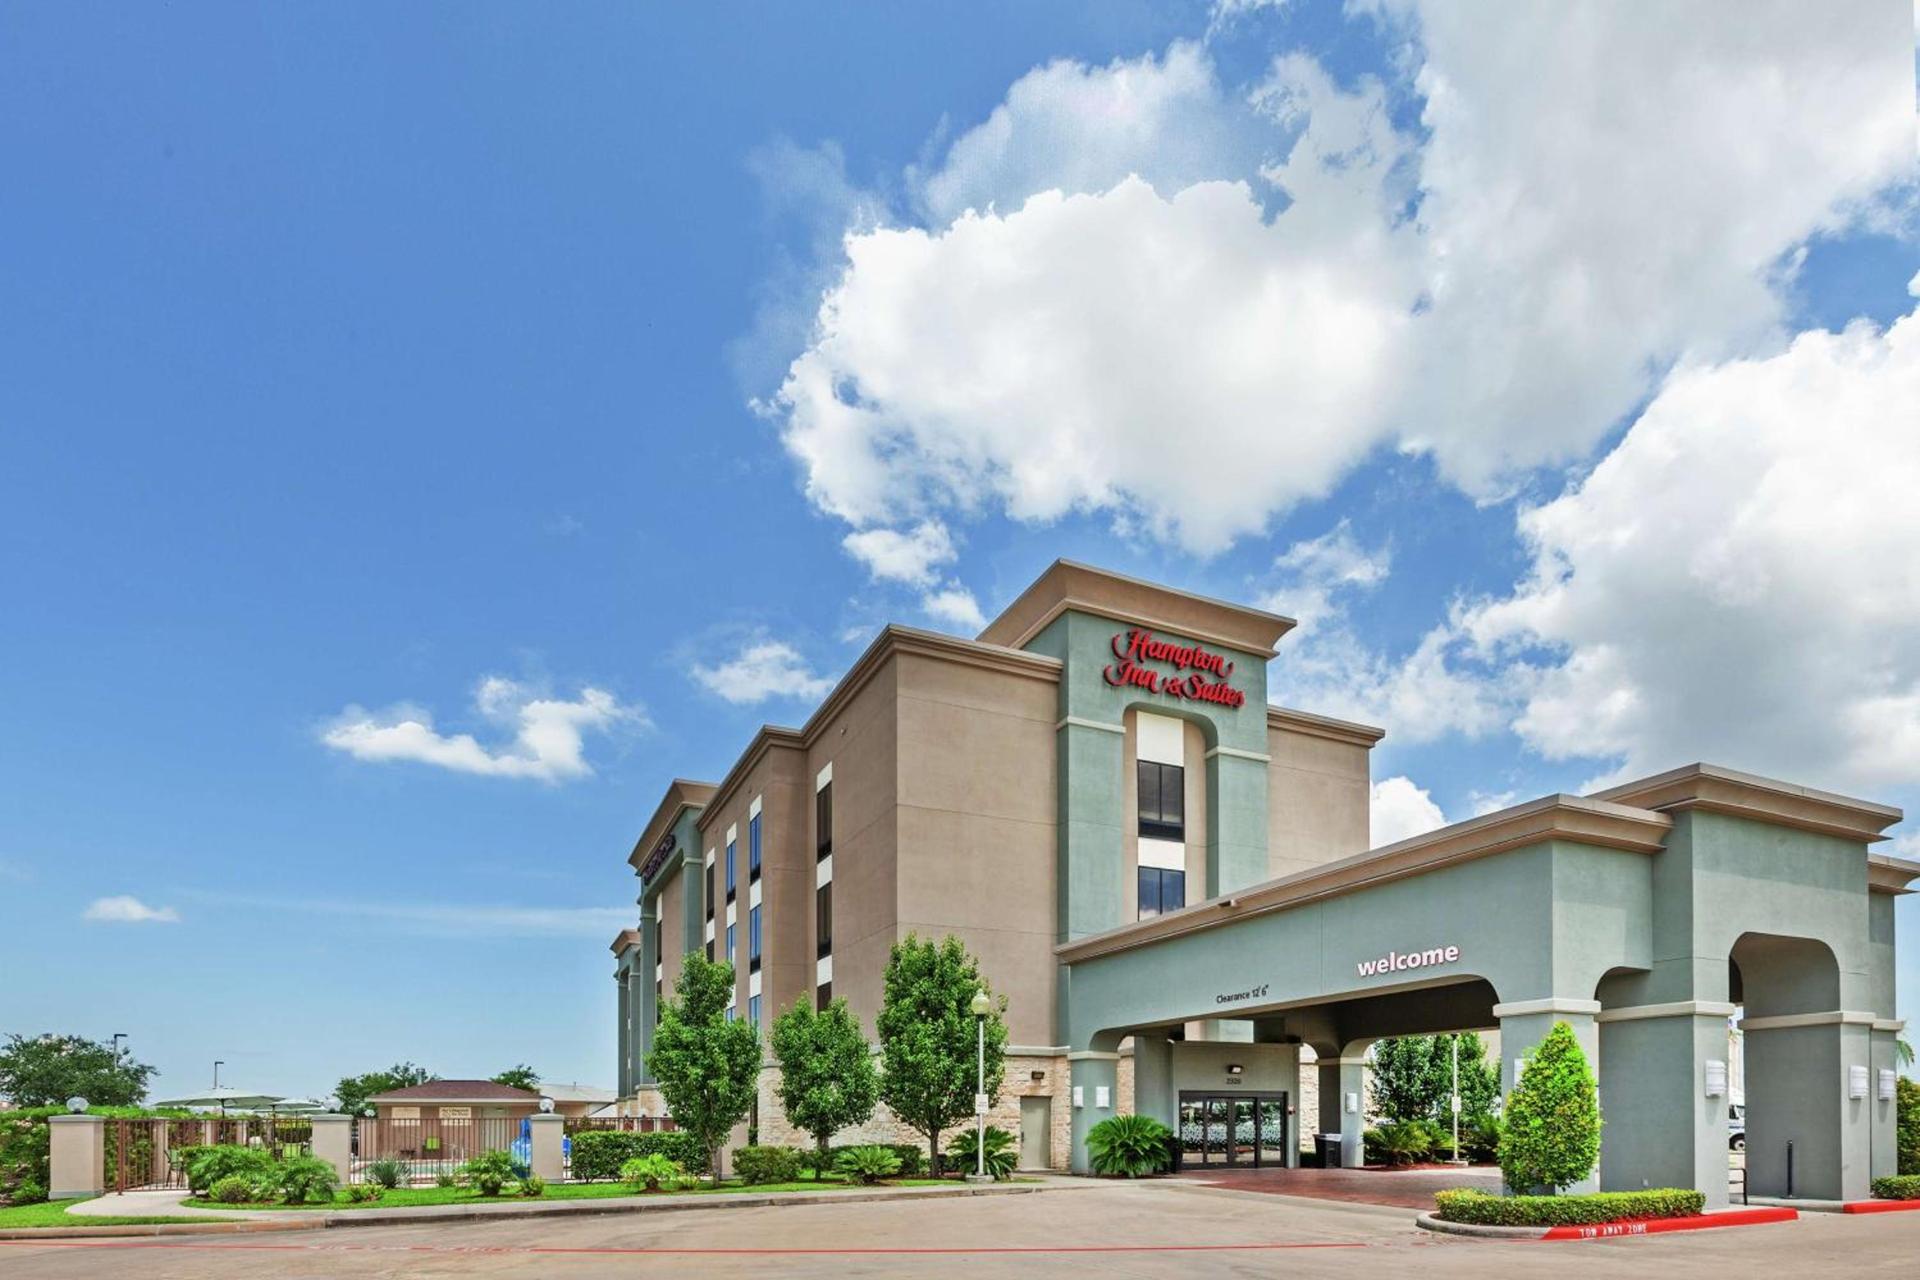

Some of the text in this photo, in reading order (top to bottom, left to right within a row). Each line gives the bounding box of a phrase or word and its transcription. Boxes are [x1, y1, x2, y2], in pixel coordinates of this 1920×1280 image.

[1112, 628, 1234, 678] Hampton
[1104, 659, 1245, 708] Inn & Suites
[1357, 945, 1459, 977] welcome
[1216, 991, 1250, 1004] Clearance
[1579, 1223, 1647, 1238] TOW AWAY ZONE
